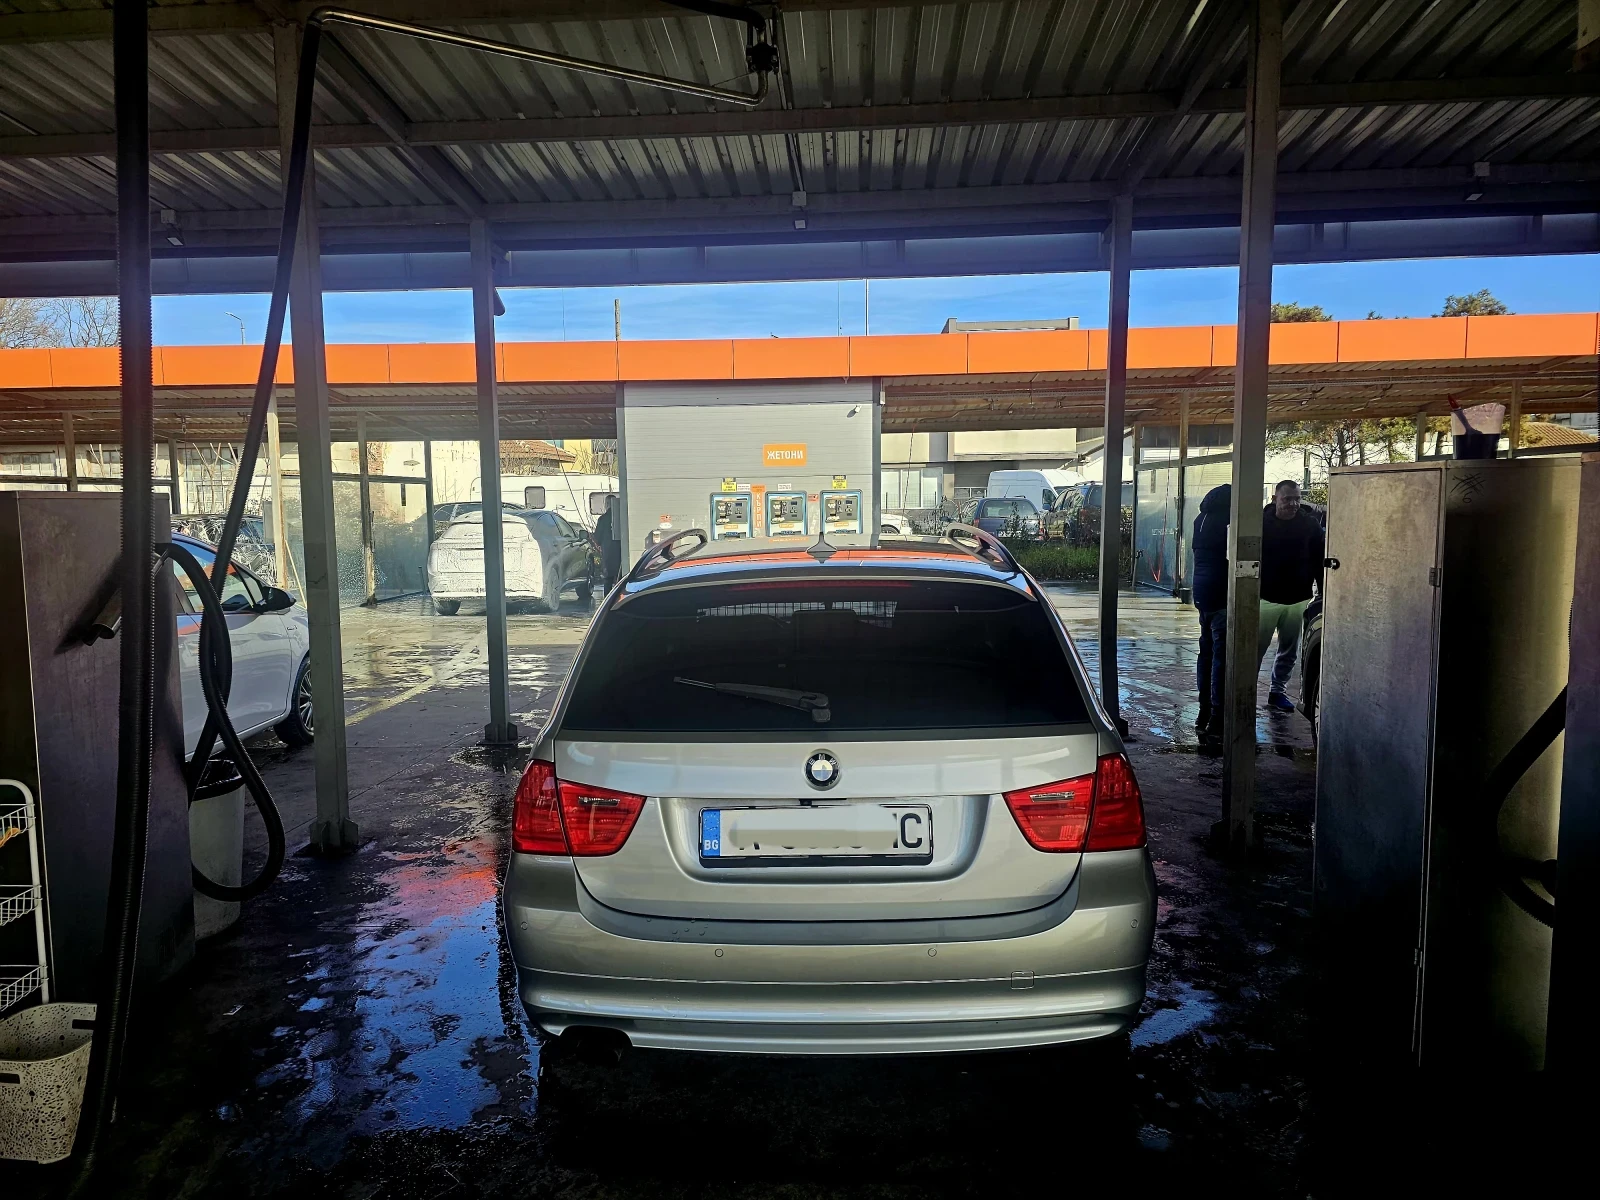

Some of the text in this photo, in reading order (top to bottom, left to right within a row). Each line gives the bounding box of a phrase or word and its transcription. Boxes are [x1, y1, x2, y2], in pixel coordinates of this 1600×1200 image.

[767, 450, 804, 460] ЖЕТОНИ
[809, 753, 837, 766] BMW
[704, 839, 719, 851] BG
